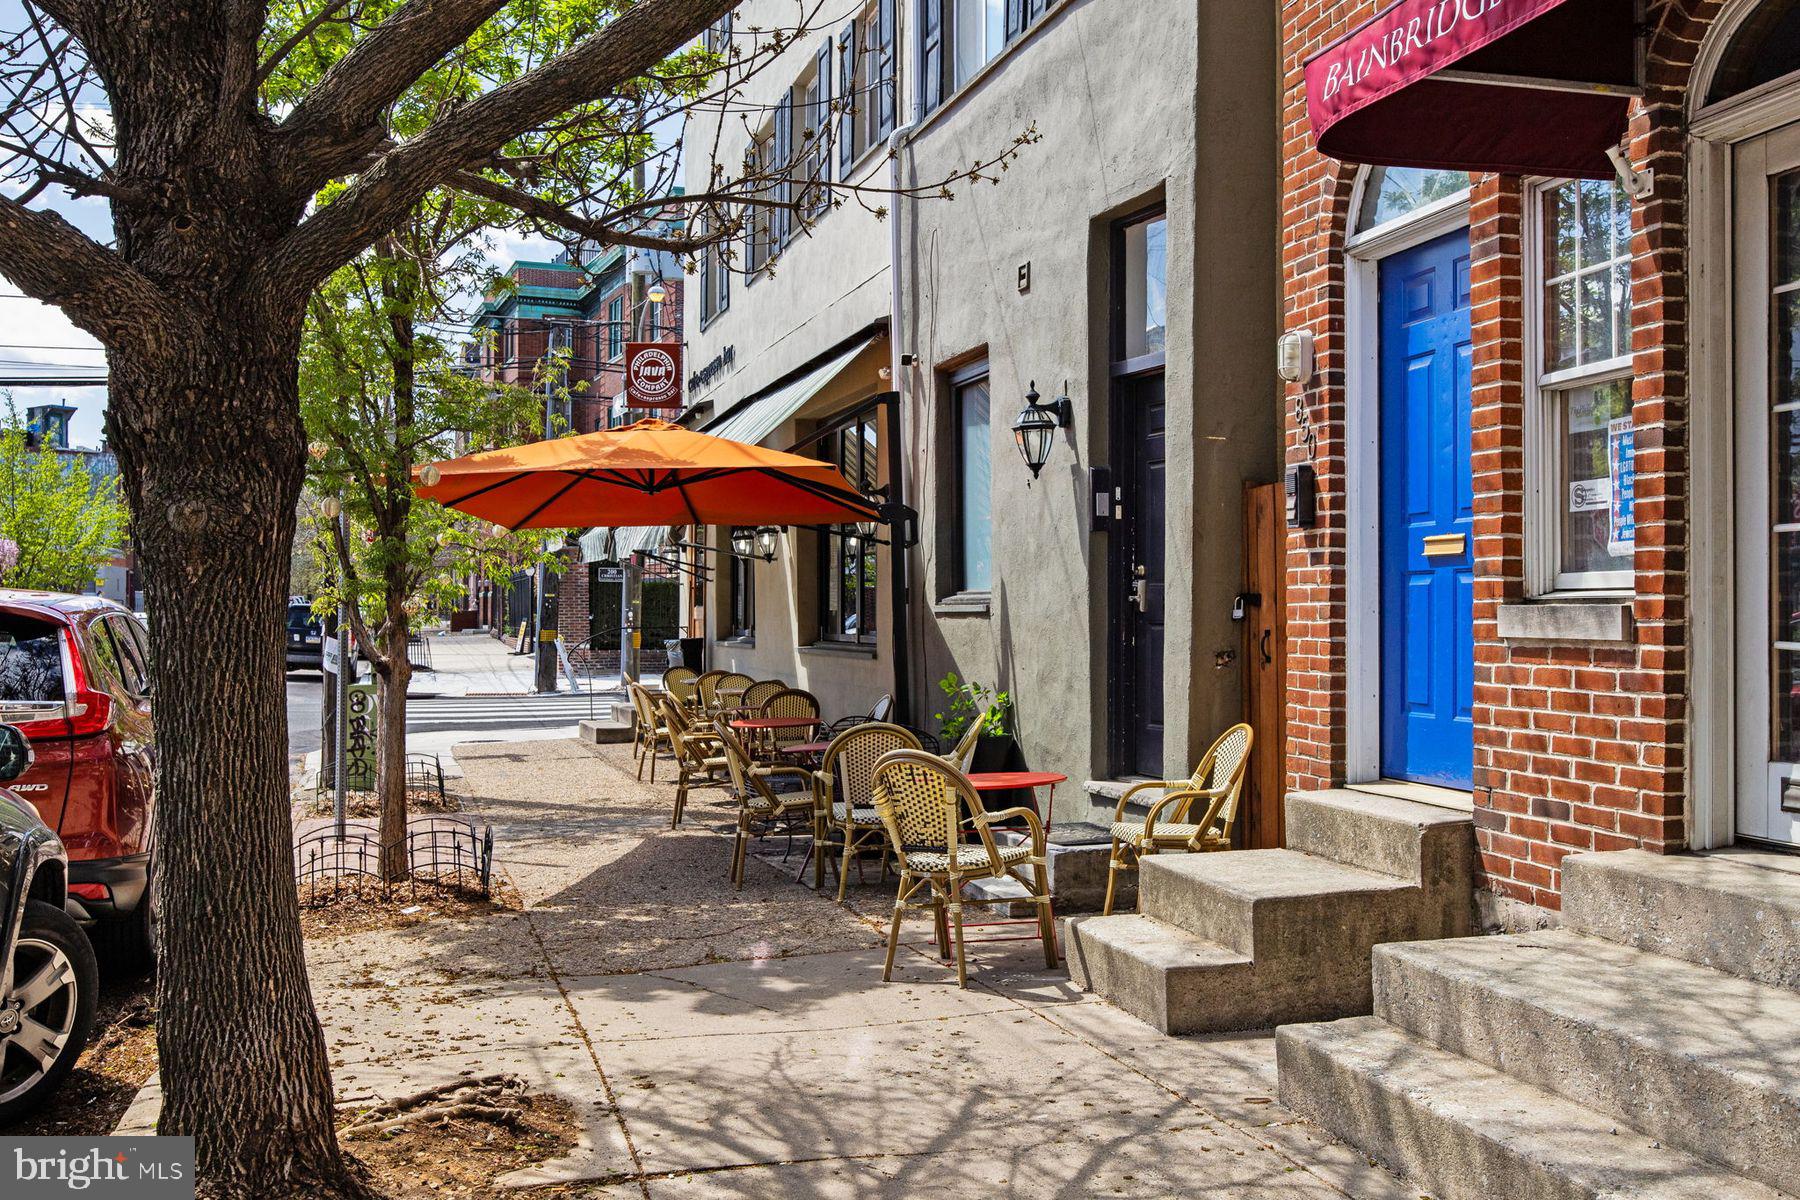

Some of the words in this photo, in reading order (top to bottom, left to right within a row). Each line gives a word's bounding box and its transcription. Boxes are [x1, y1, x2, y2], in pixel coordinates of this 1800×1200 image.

[1323, 0, 1502, 101] BAINBRIDG
[633, 351, 672, 371] PHILADELPHIA
[639, 366, 666, 377] JAVA
[636, 378, 669, 391] COMPANY
[1295, 398, 1317, 459] 850
[1610, 422, 1622, 431] WE
[1623, 420, 1633, 430] ST
[8, 783, 49, 791] AWD
